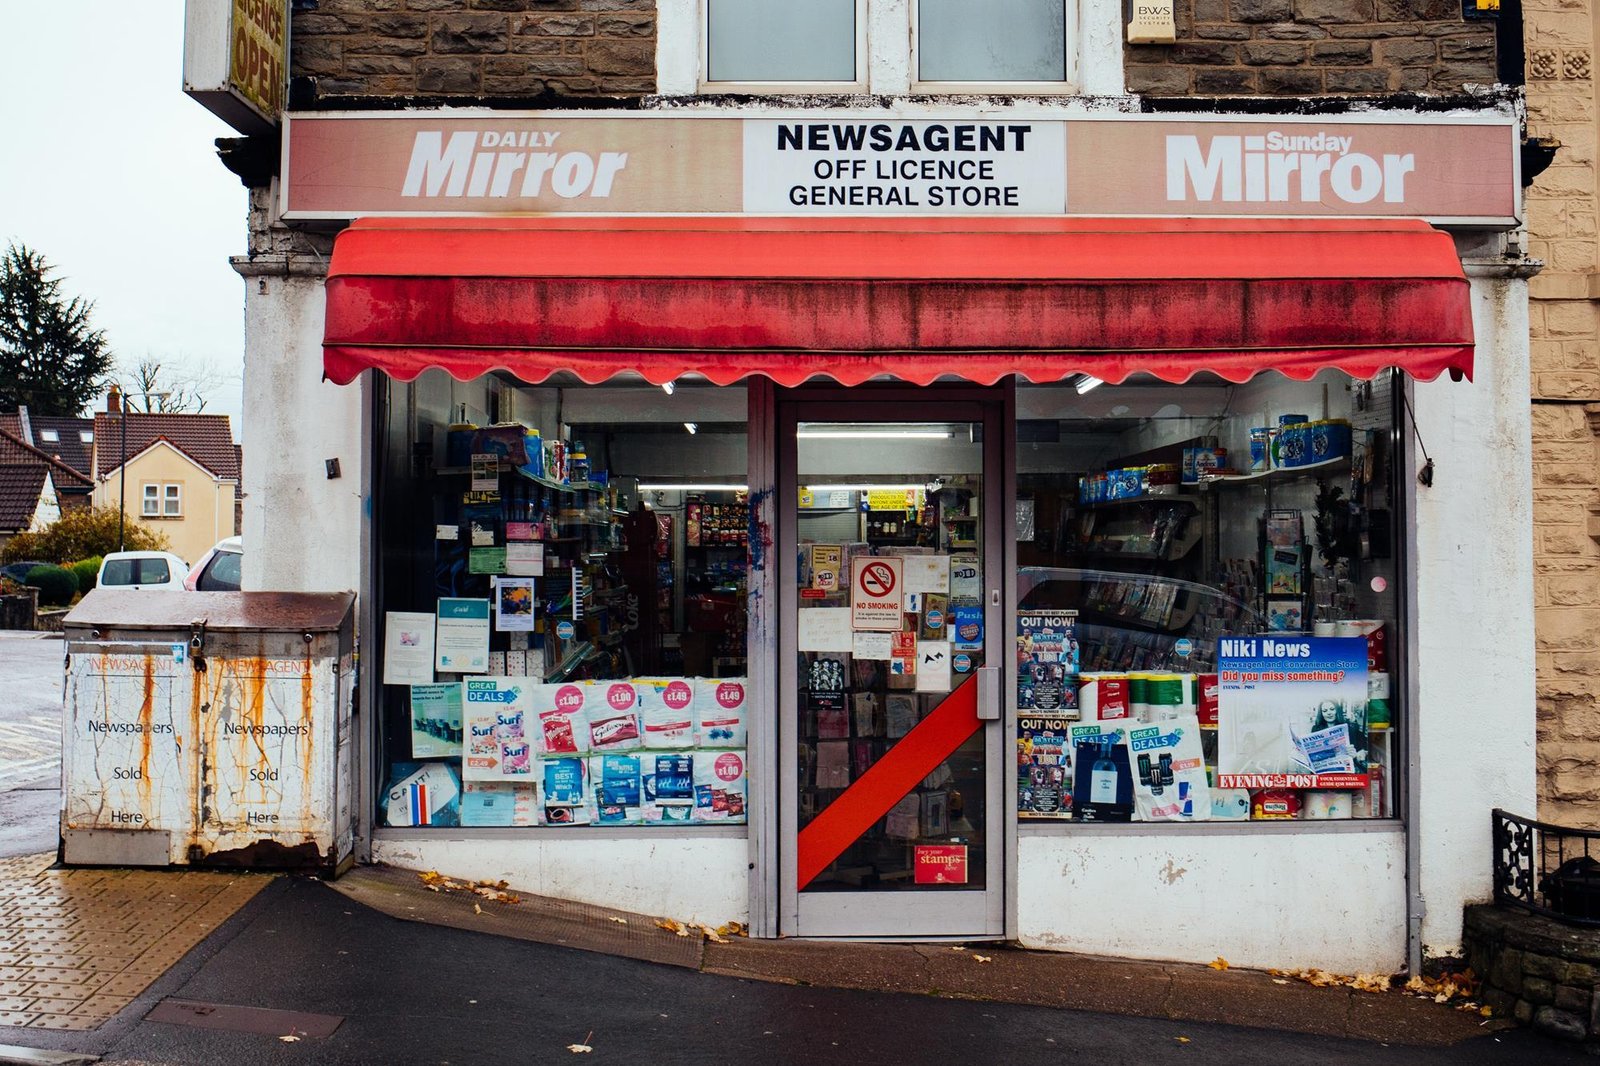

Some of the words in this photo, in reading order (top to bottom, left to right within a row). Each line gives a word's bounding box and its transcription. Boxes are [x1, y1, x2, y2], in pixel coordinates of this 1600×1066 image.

[1139, 6, 1170, 15] BWS
[236, 27, 281, 112] OPEN
[481, 131, 562, 148] DAILY
[777, 124, 1032, 152] NEWSAGENT
[1266, 131, 1352, 156] Sunday
[401, 131, 628, 198] Mirror
[814, 159, 867, 180] OFF
[876, 159, 994, 180] LICENCE
[1165, 134, 1415, 203] Mirror
[789, 185, 919, 206] GENERAL
[928, 186, 1019, 207] STORE
[868, 602, 898, 610] SMOKING
[1021, 617, 1042, 627] OUT
[1045, 617, 1075, 627] NOW!
[1221, 639, 1256, 657] Niki
[1263, 639, 1310, 657] News
[1222, 661, 1264, 669] Newsagent
[1222, 671, 1238, 681] Did
[1241, 672, 1258, 683] you
[1262, 671, 1284, 681] miss
[1287, 671, 1344, 683] something?
[469, 682, 496, 690] GREAT
[469, 692, 504, 701] DEALS
[559, 695, 580, 705] £1.00
[612, 693, 632, 702] £1.00
[667, 692, 687, 701] £1.49
[720, 691, 740, 700] £1.49
[497, 714, 521, 726] Surf
[1021, 720, 1042, 729] OUT
[88, 720, 172, 736] Newspaers
[224, 721, 308, 738] Newspapers
[471, 725, 495, 736] Surf
[1073, 727, 1099, 736] GREAT
[1132, 729, 1158, 739] GREAT
[1074, 736, 1109, 746] DEALS
[1133, 737, 1168, 751] DEALS
[504, 745, 527, 756] Surf
[114, 767, 143, 780] Sold
[249, 769, 278, 781] Sold
[718, 766, 739, 776] £1.00
[1220, 775, 1273, 788] EVENING
[1286, 775, 1319, 788] POST
[111, 811, 143, 823] Here
[247, 812, 279, 824] Here
[920, 854, 961, 867] stamps
